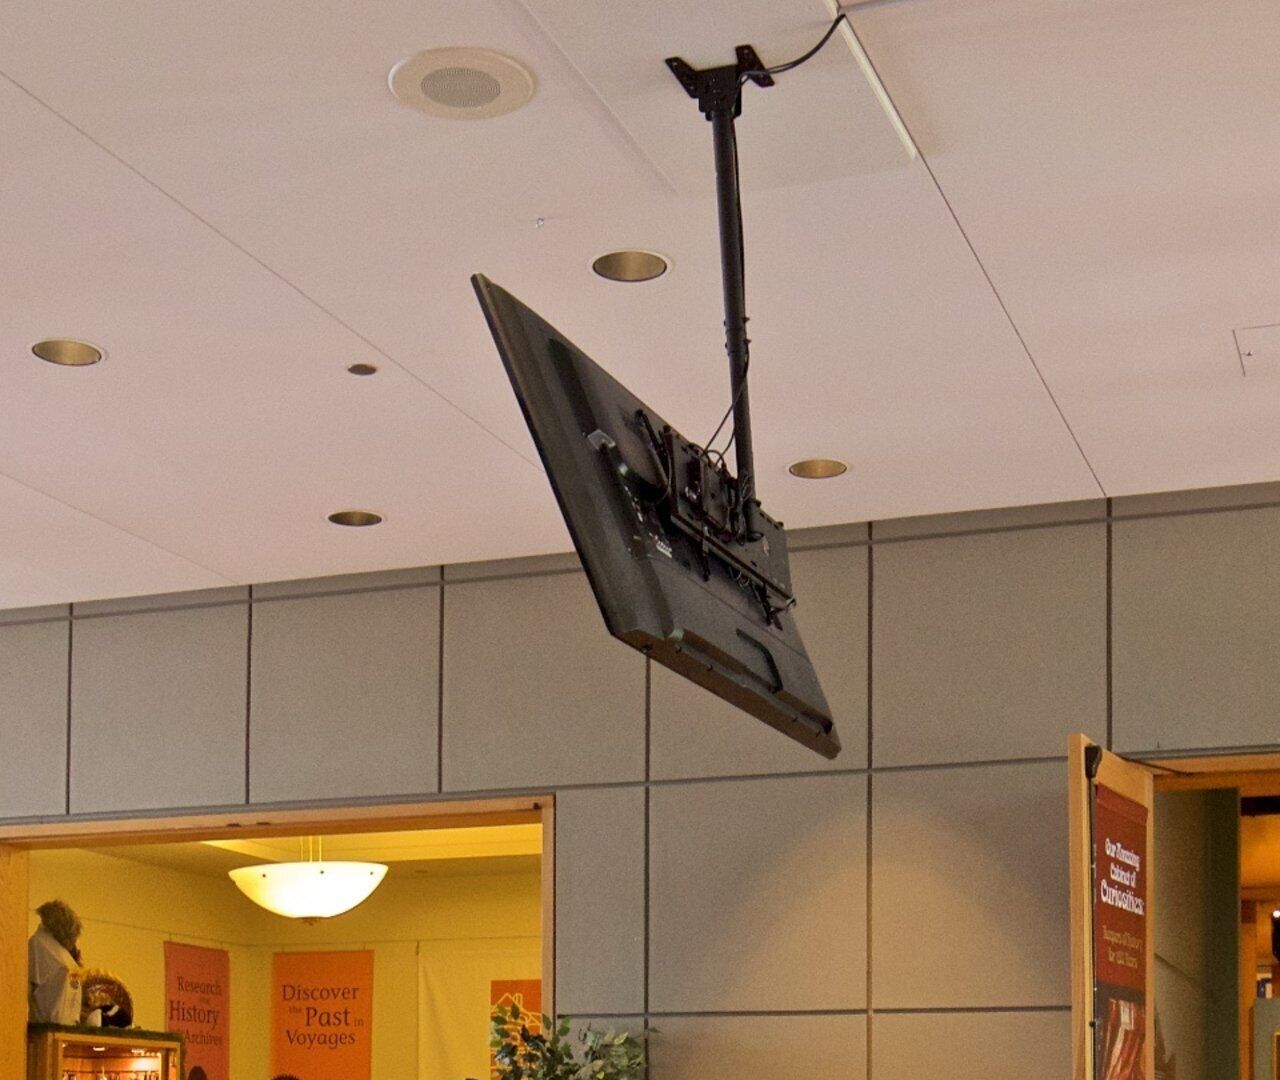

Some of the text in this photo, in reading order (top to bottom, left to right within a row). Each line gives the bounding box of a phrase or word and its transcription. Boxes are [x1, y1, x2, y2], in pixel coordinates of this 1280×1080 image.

[177, 975, 222, 996] Research
[282, 984, 360, 1001] Discover
[169, 1000, 220, 1031] History
[306, 1006, 351, 1027] Past
[286, 1029, 357, 1050] Voyages
